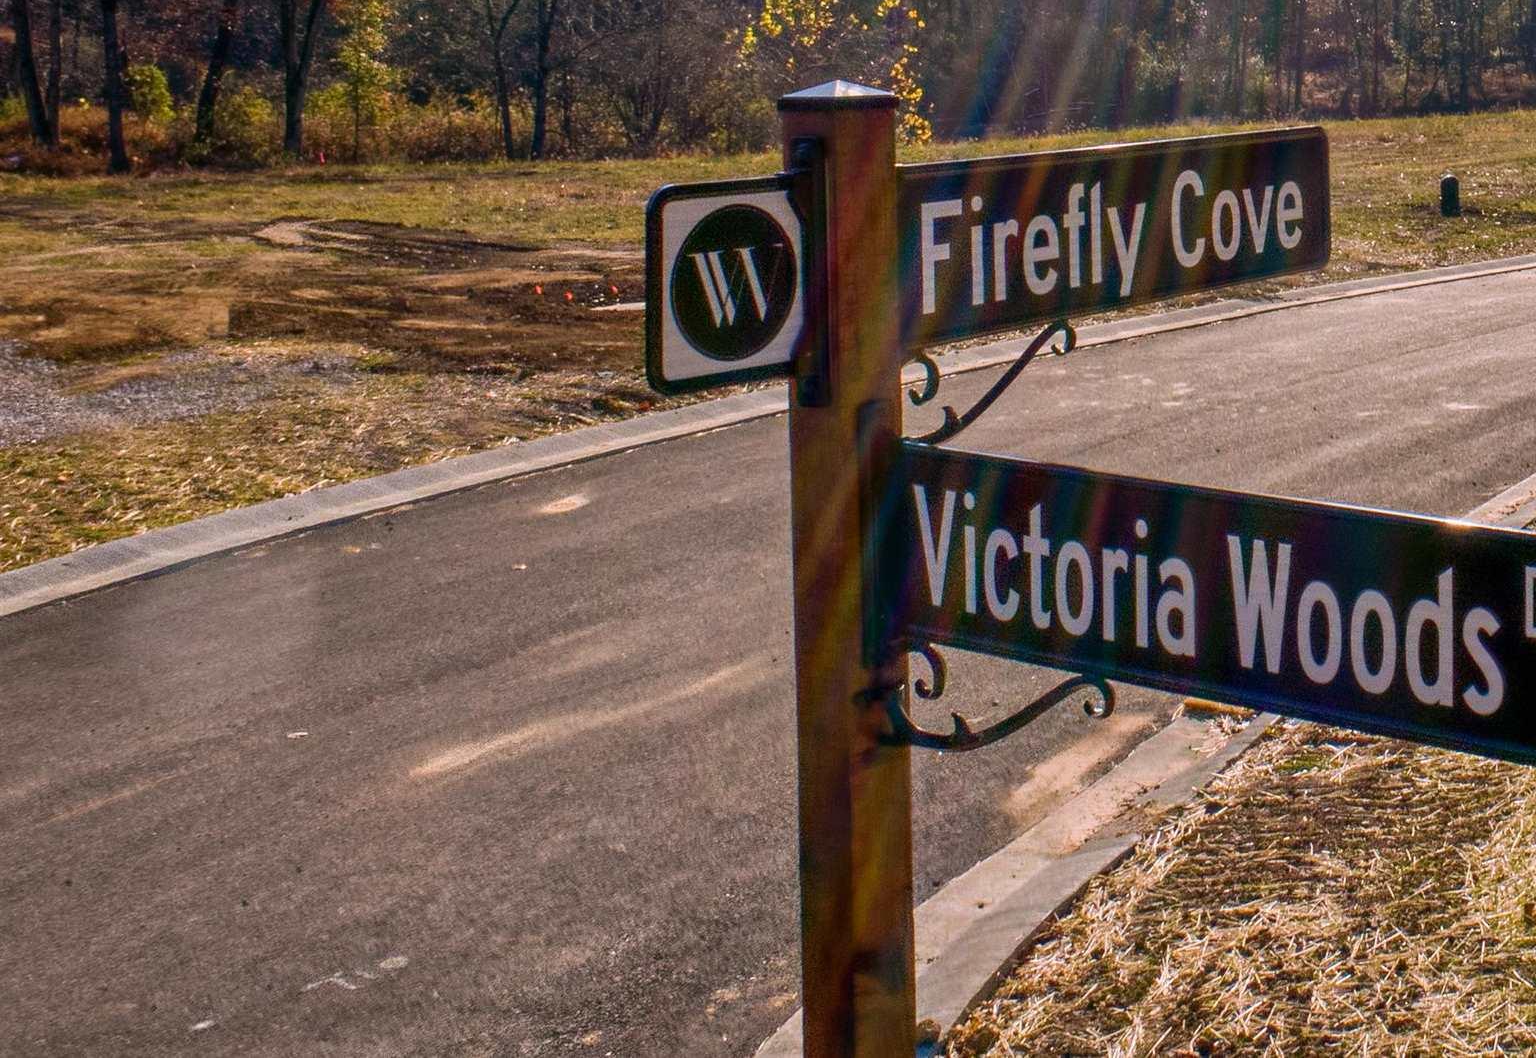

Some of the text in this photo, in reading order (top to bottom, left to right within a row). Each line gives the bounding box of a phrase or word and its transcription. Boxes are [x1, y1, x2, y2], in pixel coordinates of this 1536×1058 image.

[920, 170, 1304, 313] Firefly Cove
[912, 484, 1196, 657] Victoria
[1228, 534, 1505, 716] Woods
